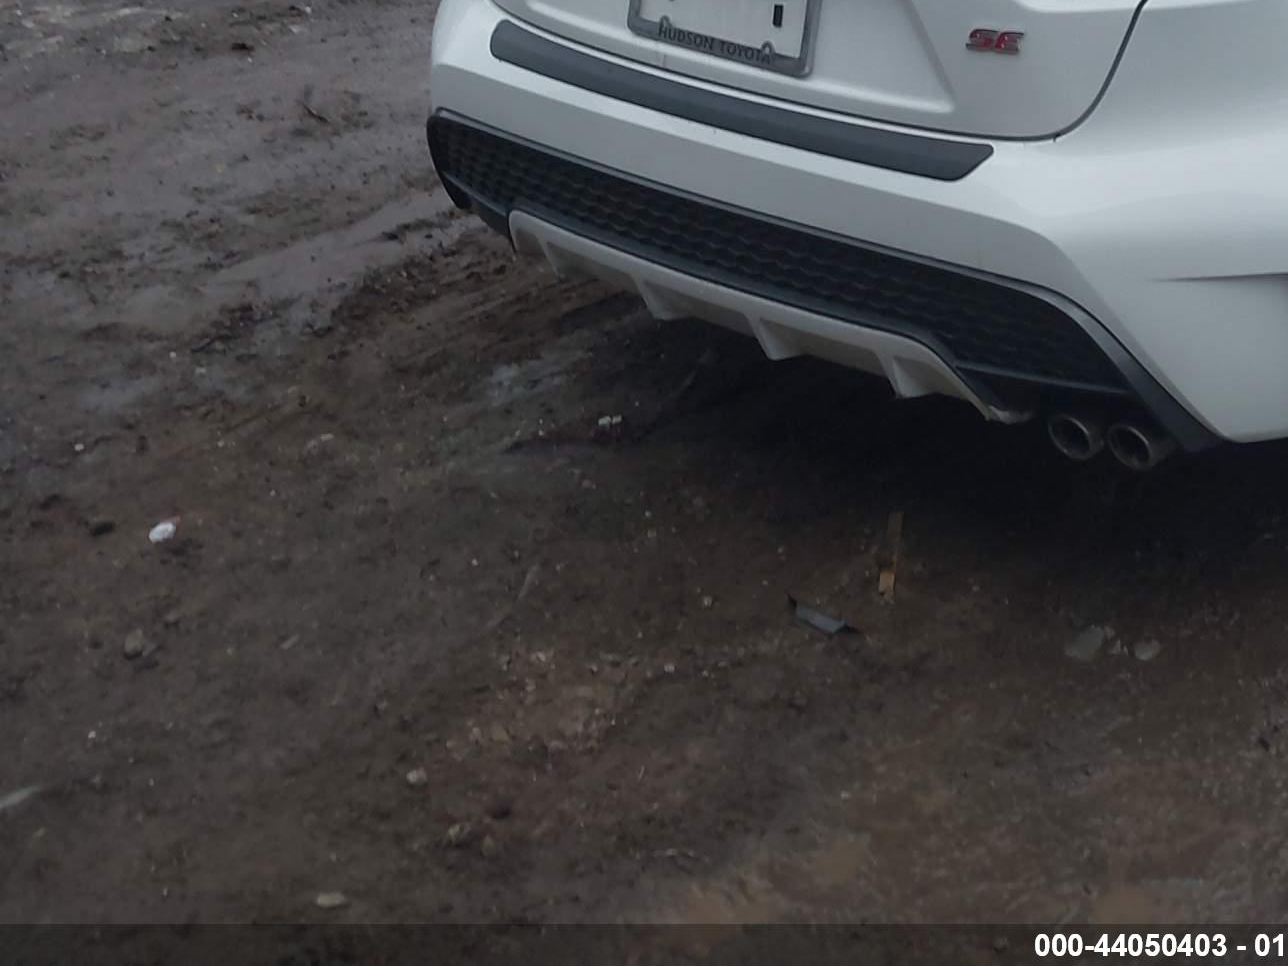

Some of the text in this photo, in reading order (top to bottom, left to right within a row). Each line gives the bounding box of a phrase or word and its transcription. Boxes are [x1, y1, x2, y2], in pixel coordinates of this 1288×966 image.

[658, 24, 773, 65] HUDSON TOYOTA
[965, 28, 1025, 54] SE
